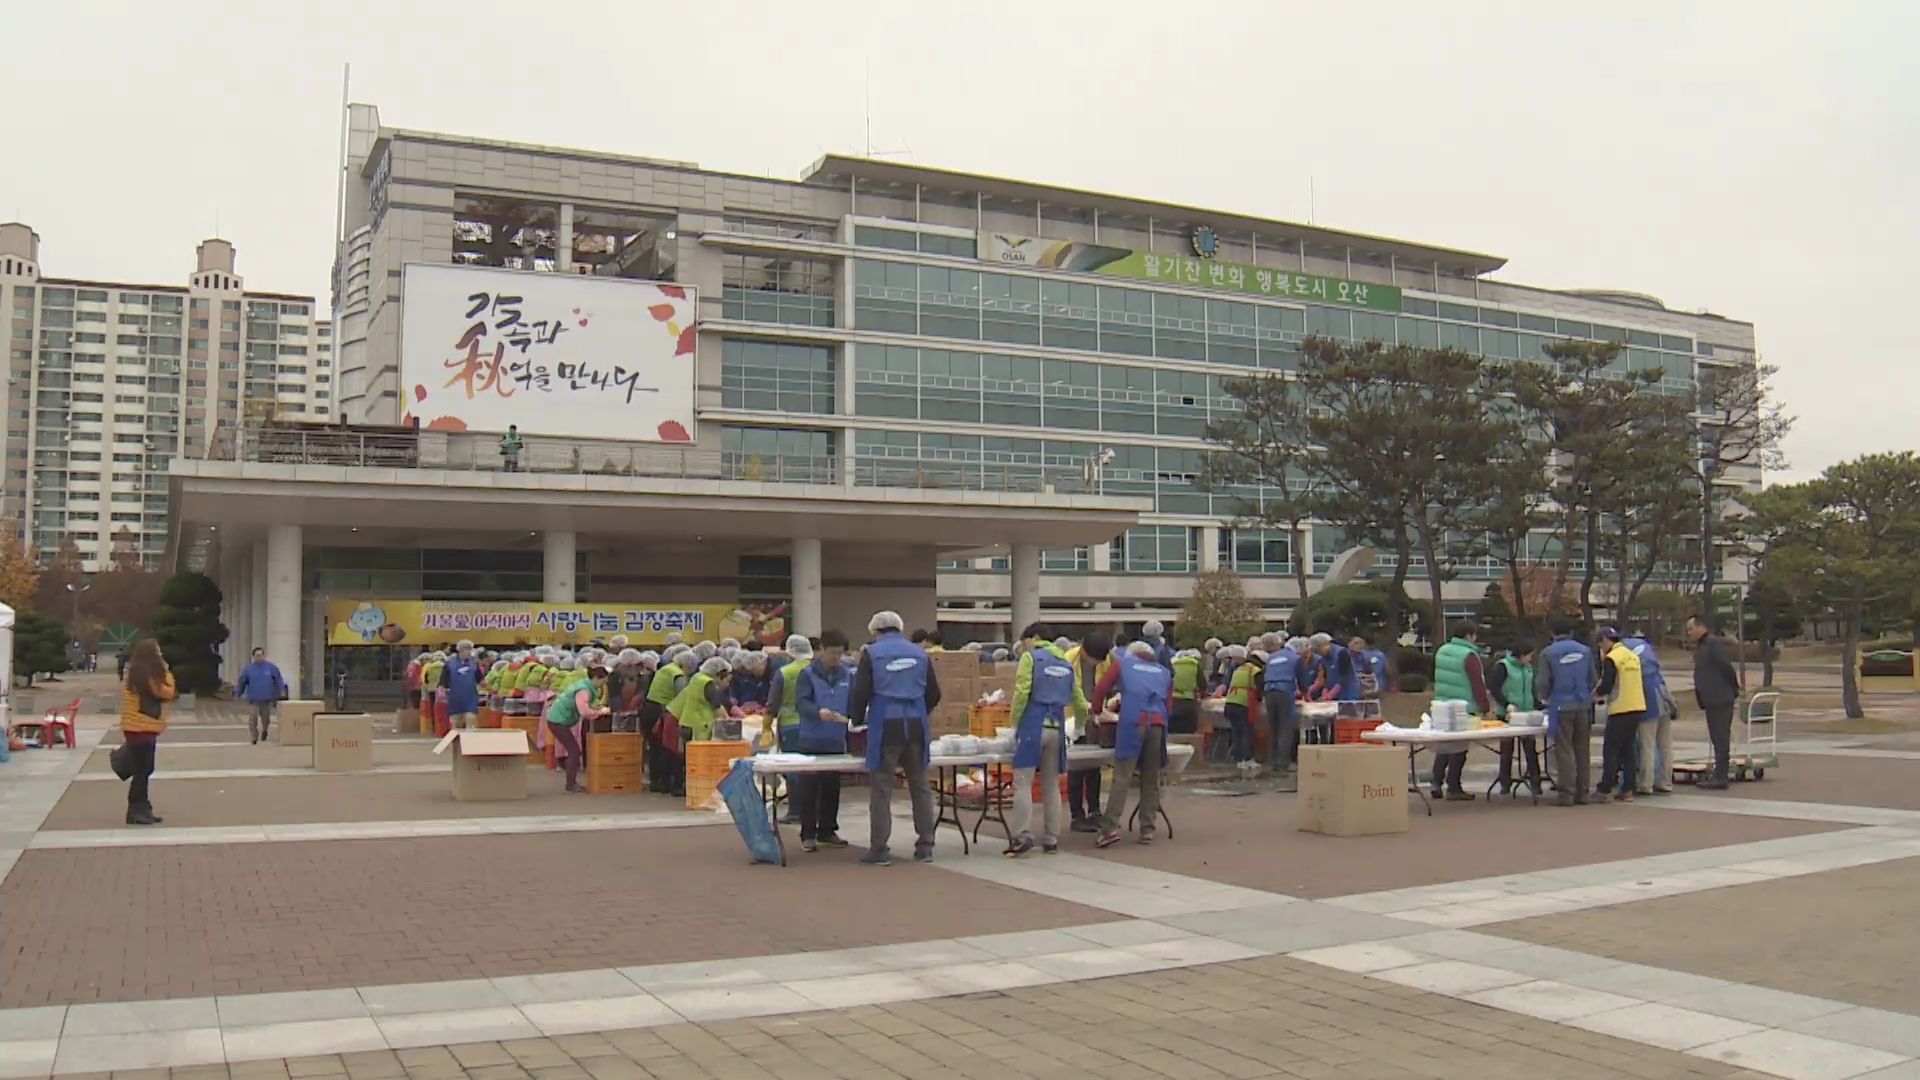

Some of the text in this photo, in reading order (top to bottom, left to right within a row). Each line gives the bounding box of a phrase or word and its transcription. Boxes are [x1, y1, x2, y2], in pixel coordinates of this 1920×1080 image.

[1002, 252, 1026, 262] OSAN
[1144, 253, 1369, 305] 활기찬 변화 행복도시 오산
[465, 292, 569, 354] 가족과
[558, 360, 660, 404] 만나다
[535, 610, 619, 632] 사랑나눔
[624, 610, 703, 632] 김장축제
[1361, 783, 1395, 799] Point
